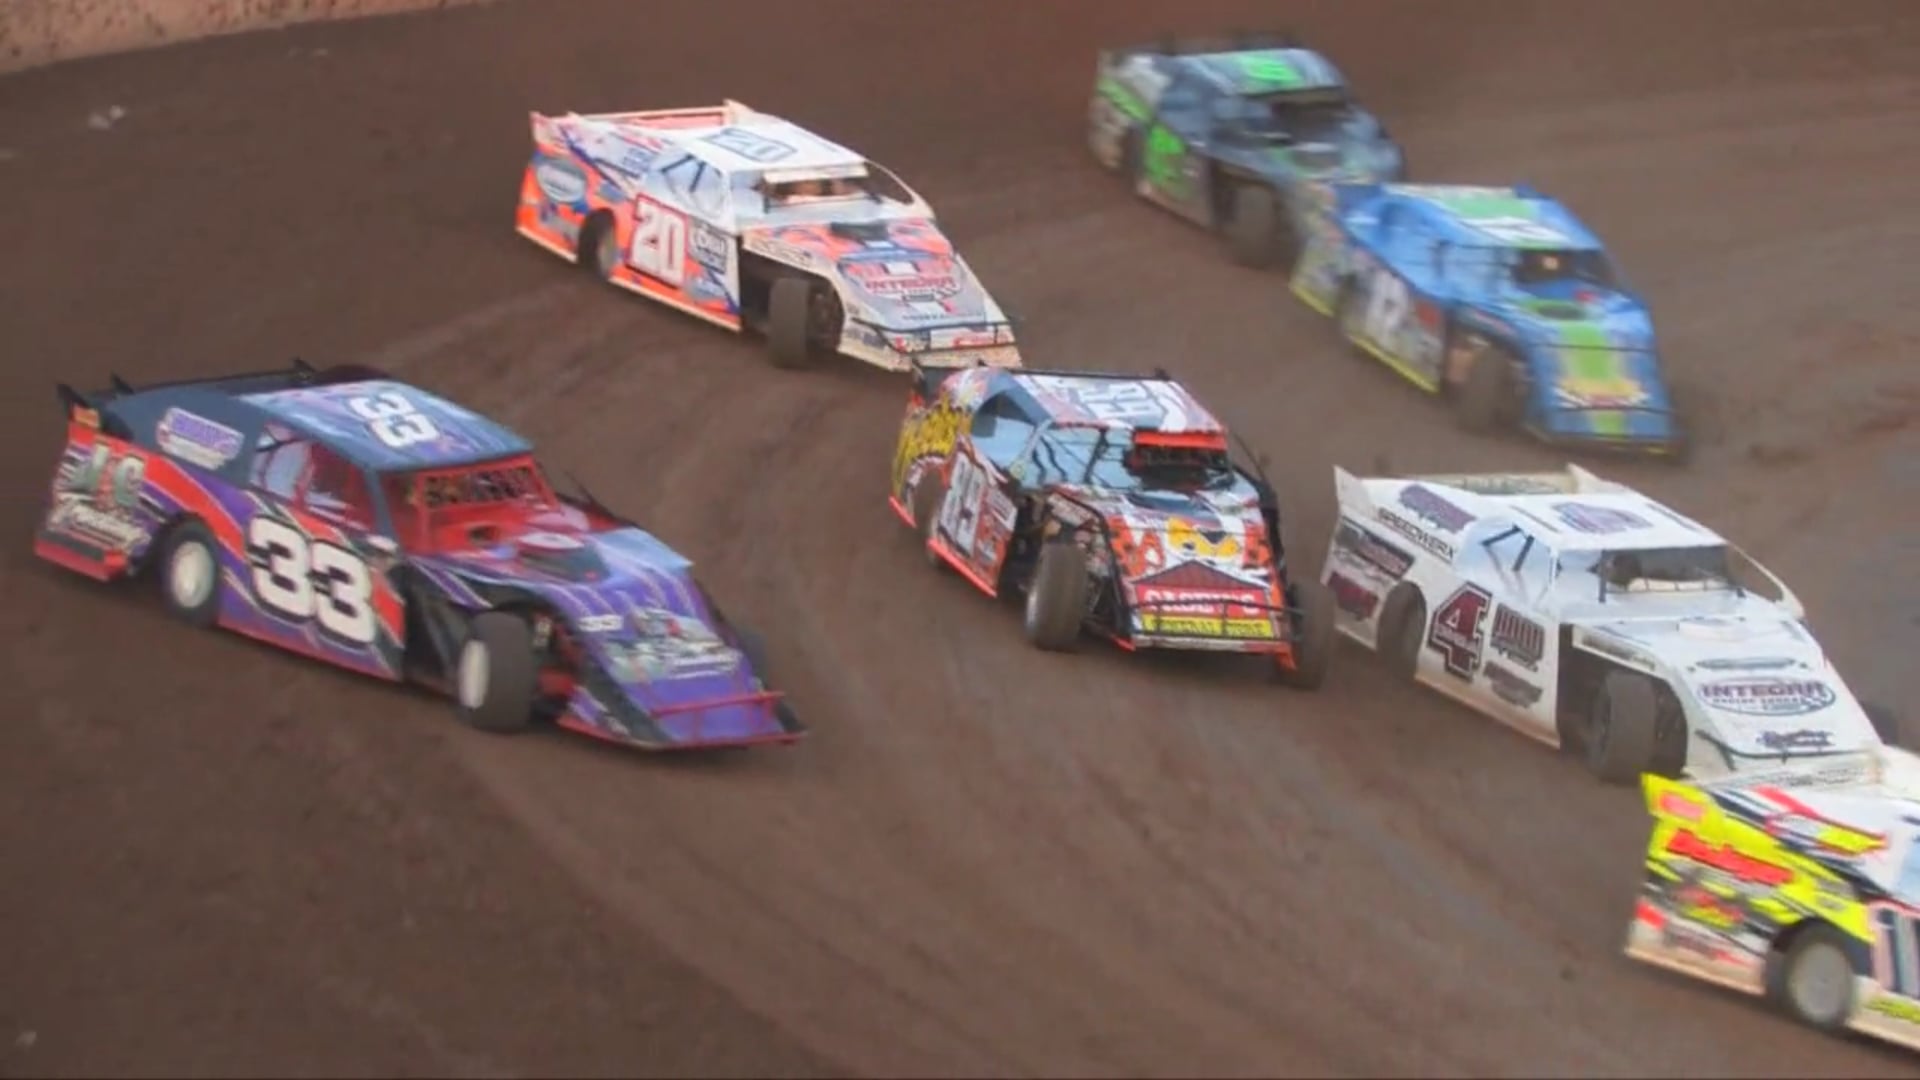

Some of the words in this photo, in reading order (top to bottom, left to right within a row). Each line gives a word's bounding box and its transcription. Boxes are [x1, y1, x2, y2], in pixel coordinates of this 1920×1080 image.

[628, 199, 688, 286] 20
[348, 392, 440, 449] 33
[248, 514, 376, 643] 33
[1426, 580, 1493, 683] 4
[1701, 680, 1828, 699] INTEGRA
